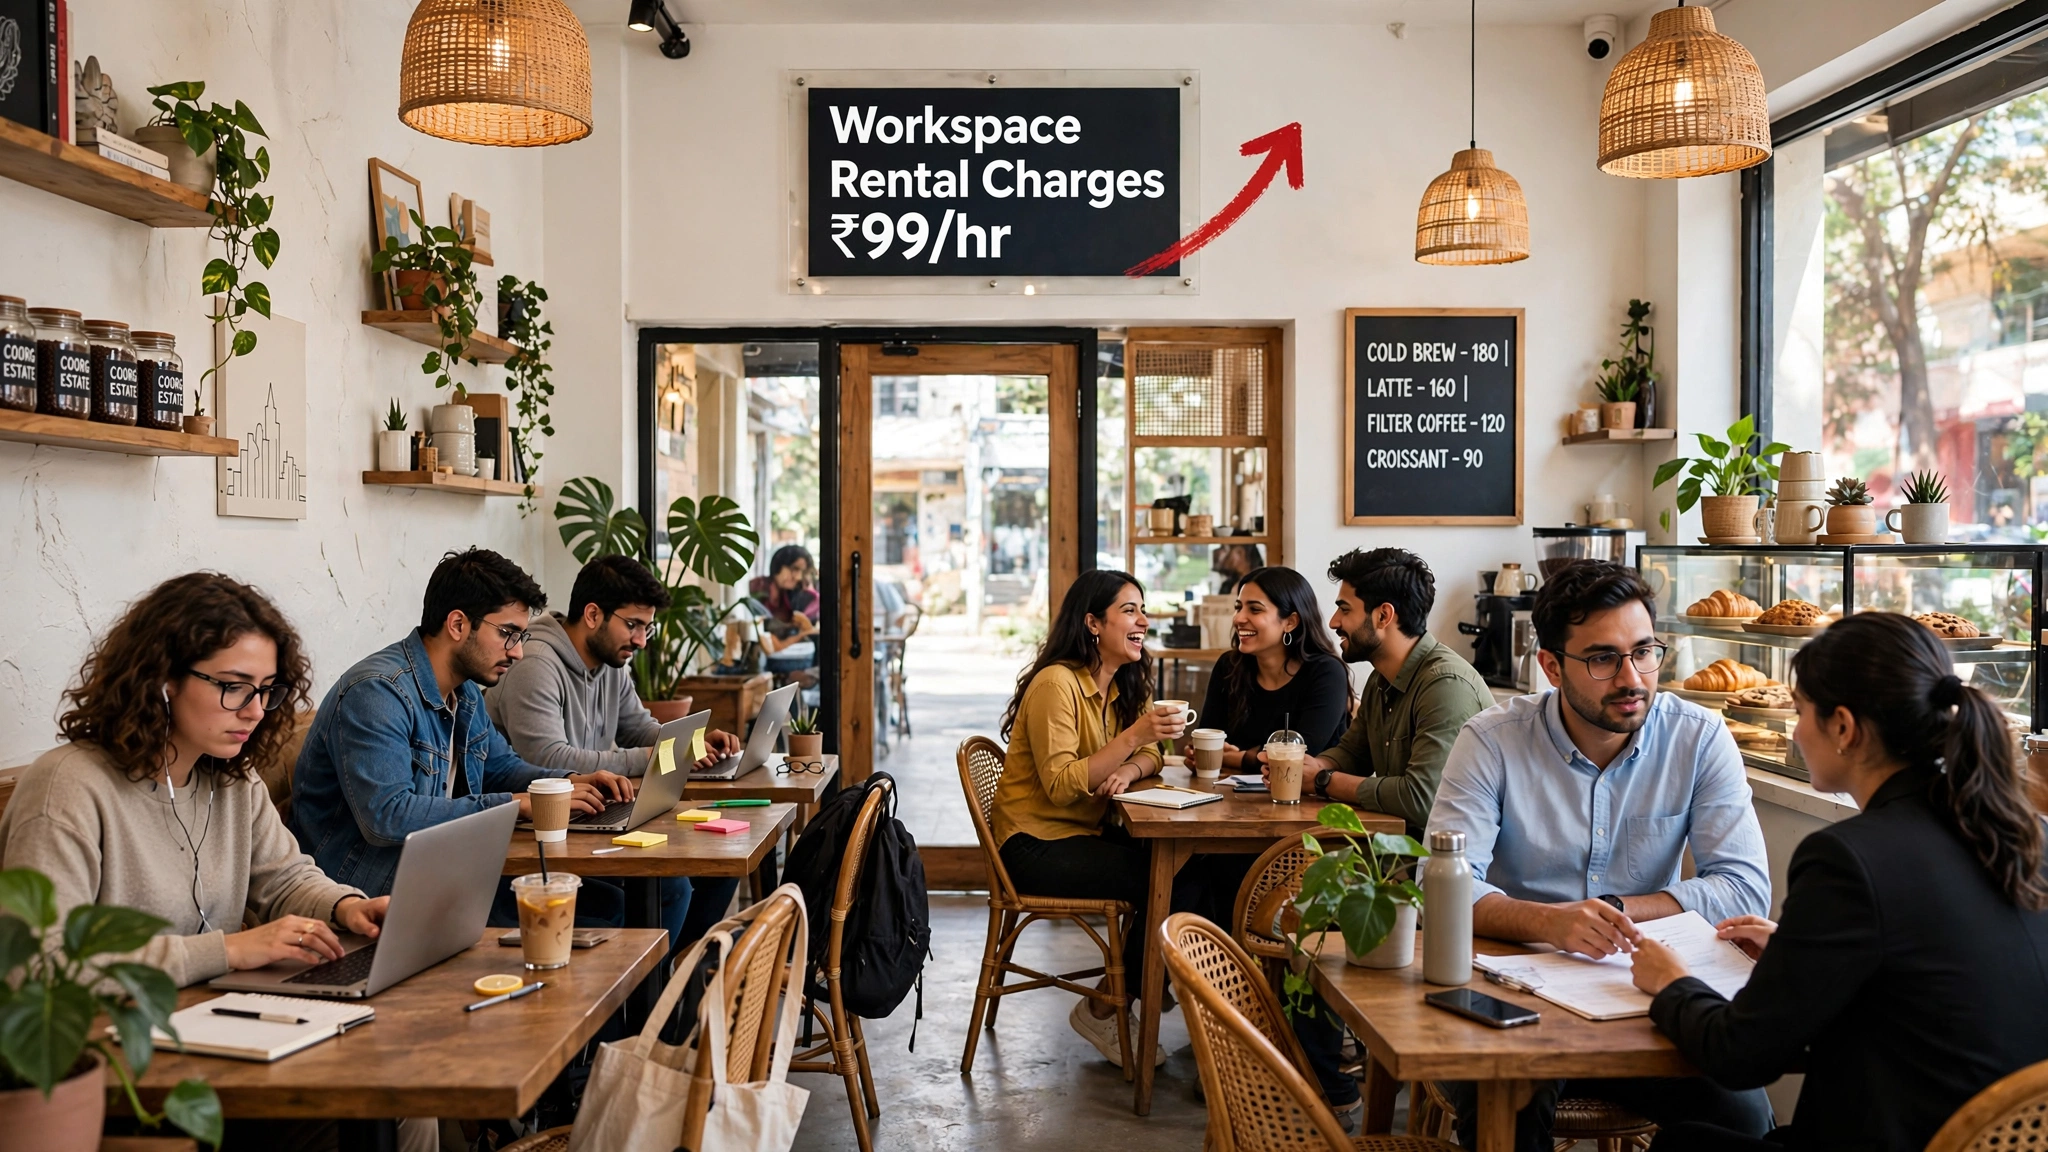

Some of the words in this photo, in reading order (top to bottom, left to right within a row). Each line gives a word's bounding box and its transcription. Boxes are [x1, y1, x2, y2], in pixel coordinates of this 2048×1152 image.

[829, 105, 1081, 153] Workspace
[831, 159, 969, 199] Rental
[982, 159, 1165, 209] Charges
[831, 208, 1012, 265] ₹99/hr
[3, 344, 36, 363] COORG
[1367, 342, 1408, 362] COLD
[1412, 342, 1457, 362] BREW
[1471, 342, 1499, 362] 180
[3, 362, 36, 381] ESTATE
[60, 355, 90, 374] COORG
[110, 366, 138, 382] COORG
[60, 373, 90, 391] ESTATE
[110, 382, 138, 399] ESTATE
[1367, 378, 1413, 398] LATTE
[1429, 378, 1457, 398] 160
[158, 391, 183, 406] ESTATE
[1367, 413, 1414, 433] FILTER
[1417, 413, 1468, 433] COFFEE
[1480, 413, 1506, 433] 120
[1367, 449, 1450, 469] CROISSANT
[1463, 449, 1484, 469] 90
